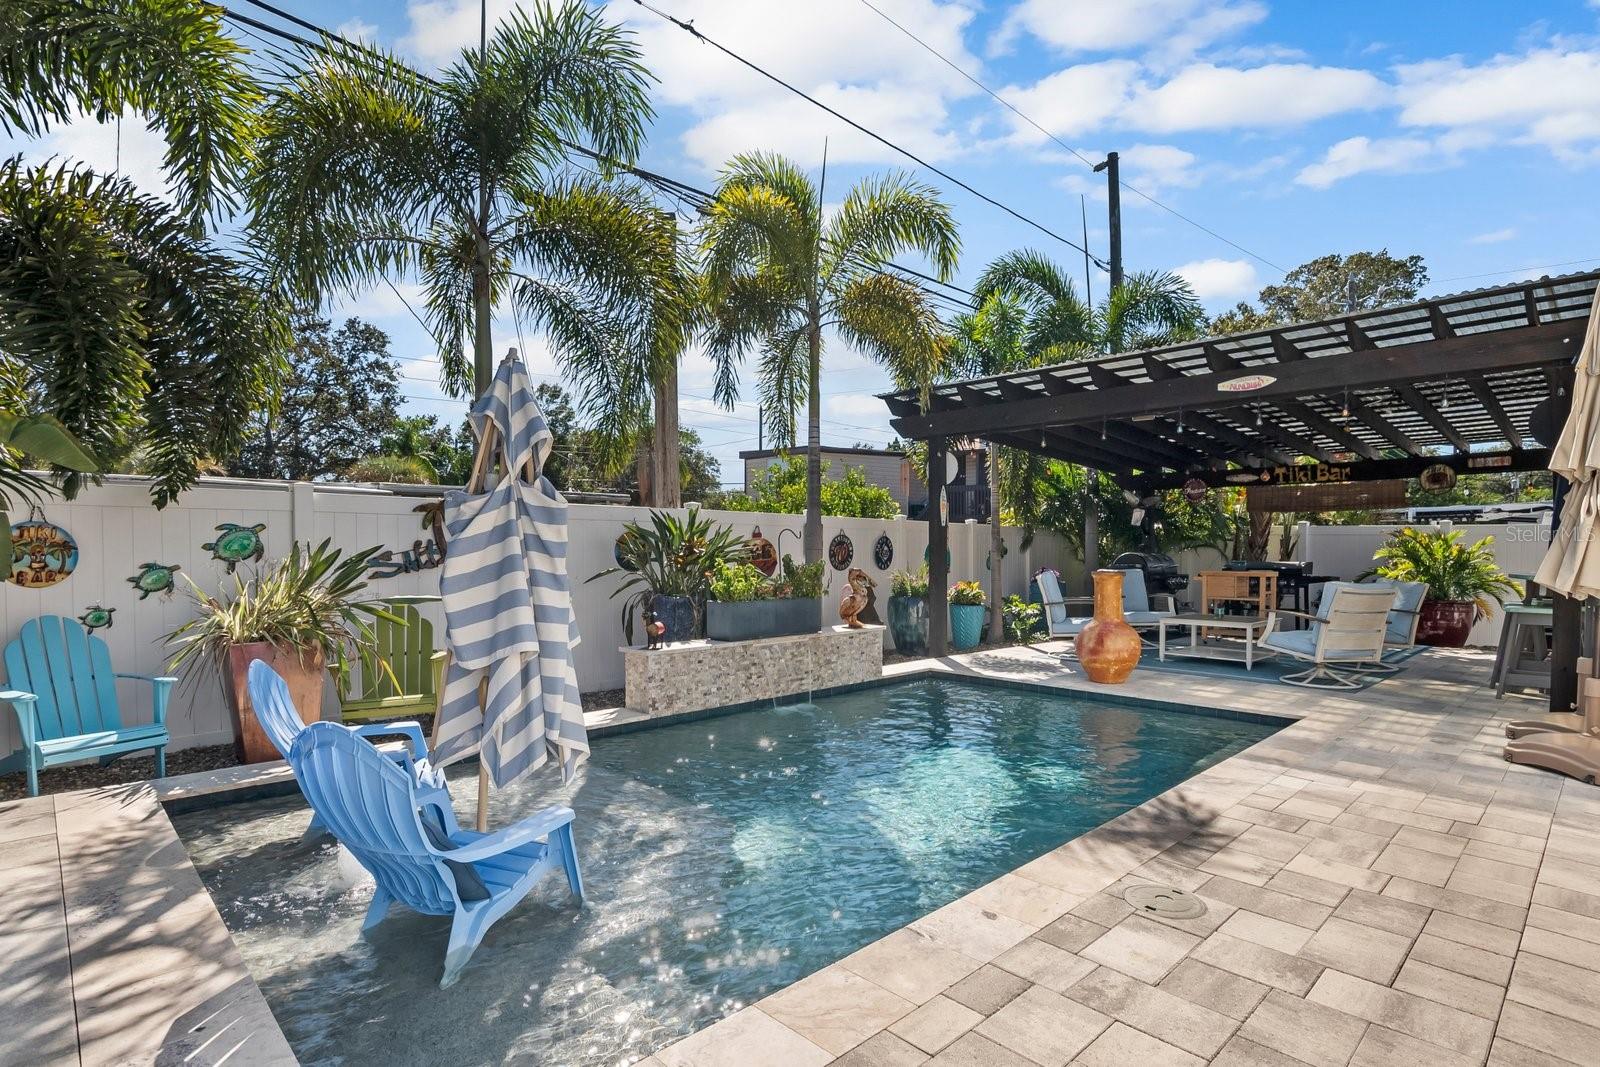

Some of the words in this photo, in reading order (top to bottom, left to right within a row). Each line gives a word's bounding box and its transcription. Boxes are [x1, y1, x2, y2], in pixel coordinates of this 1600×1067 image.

[1274, 465, 1311, 483] Tiki
[1316, 463, 1351, 481] Bar
[15, 526, 58, 541] TIKI
[17, 570, 57, 586] BAR
